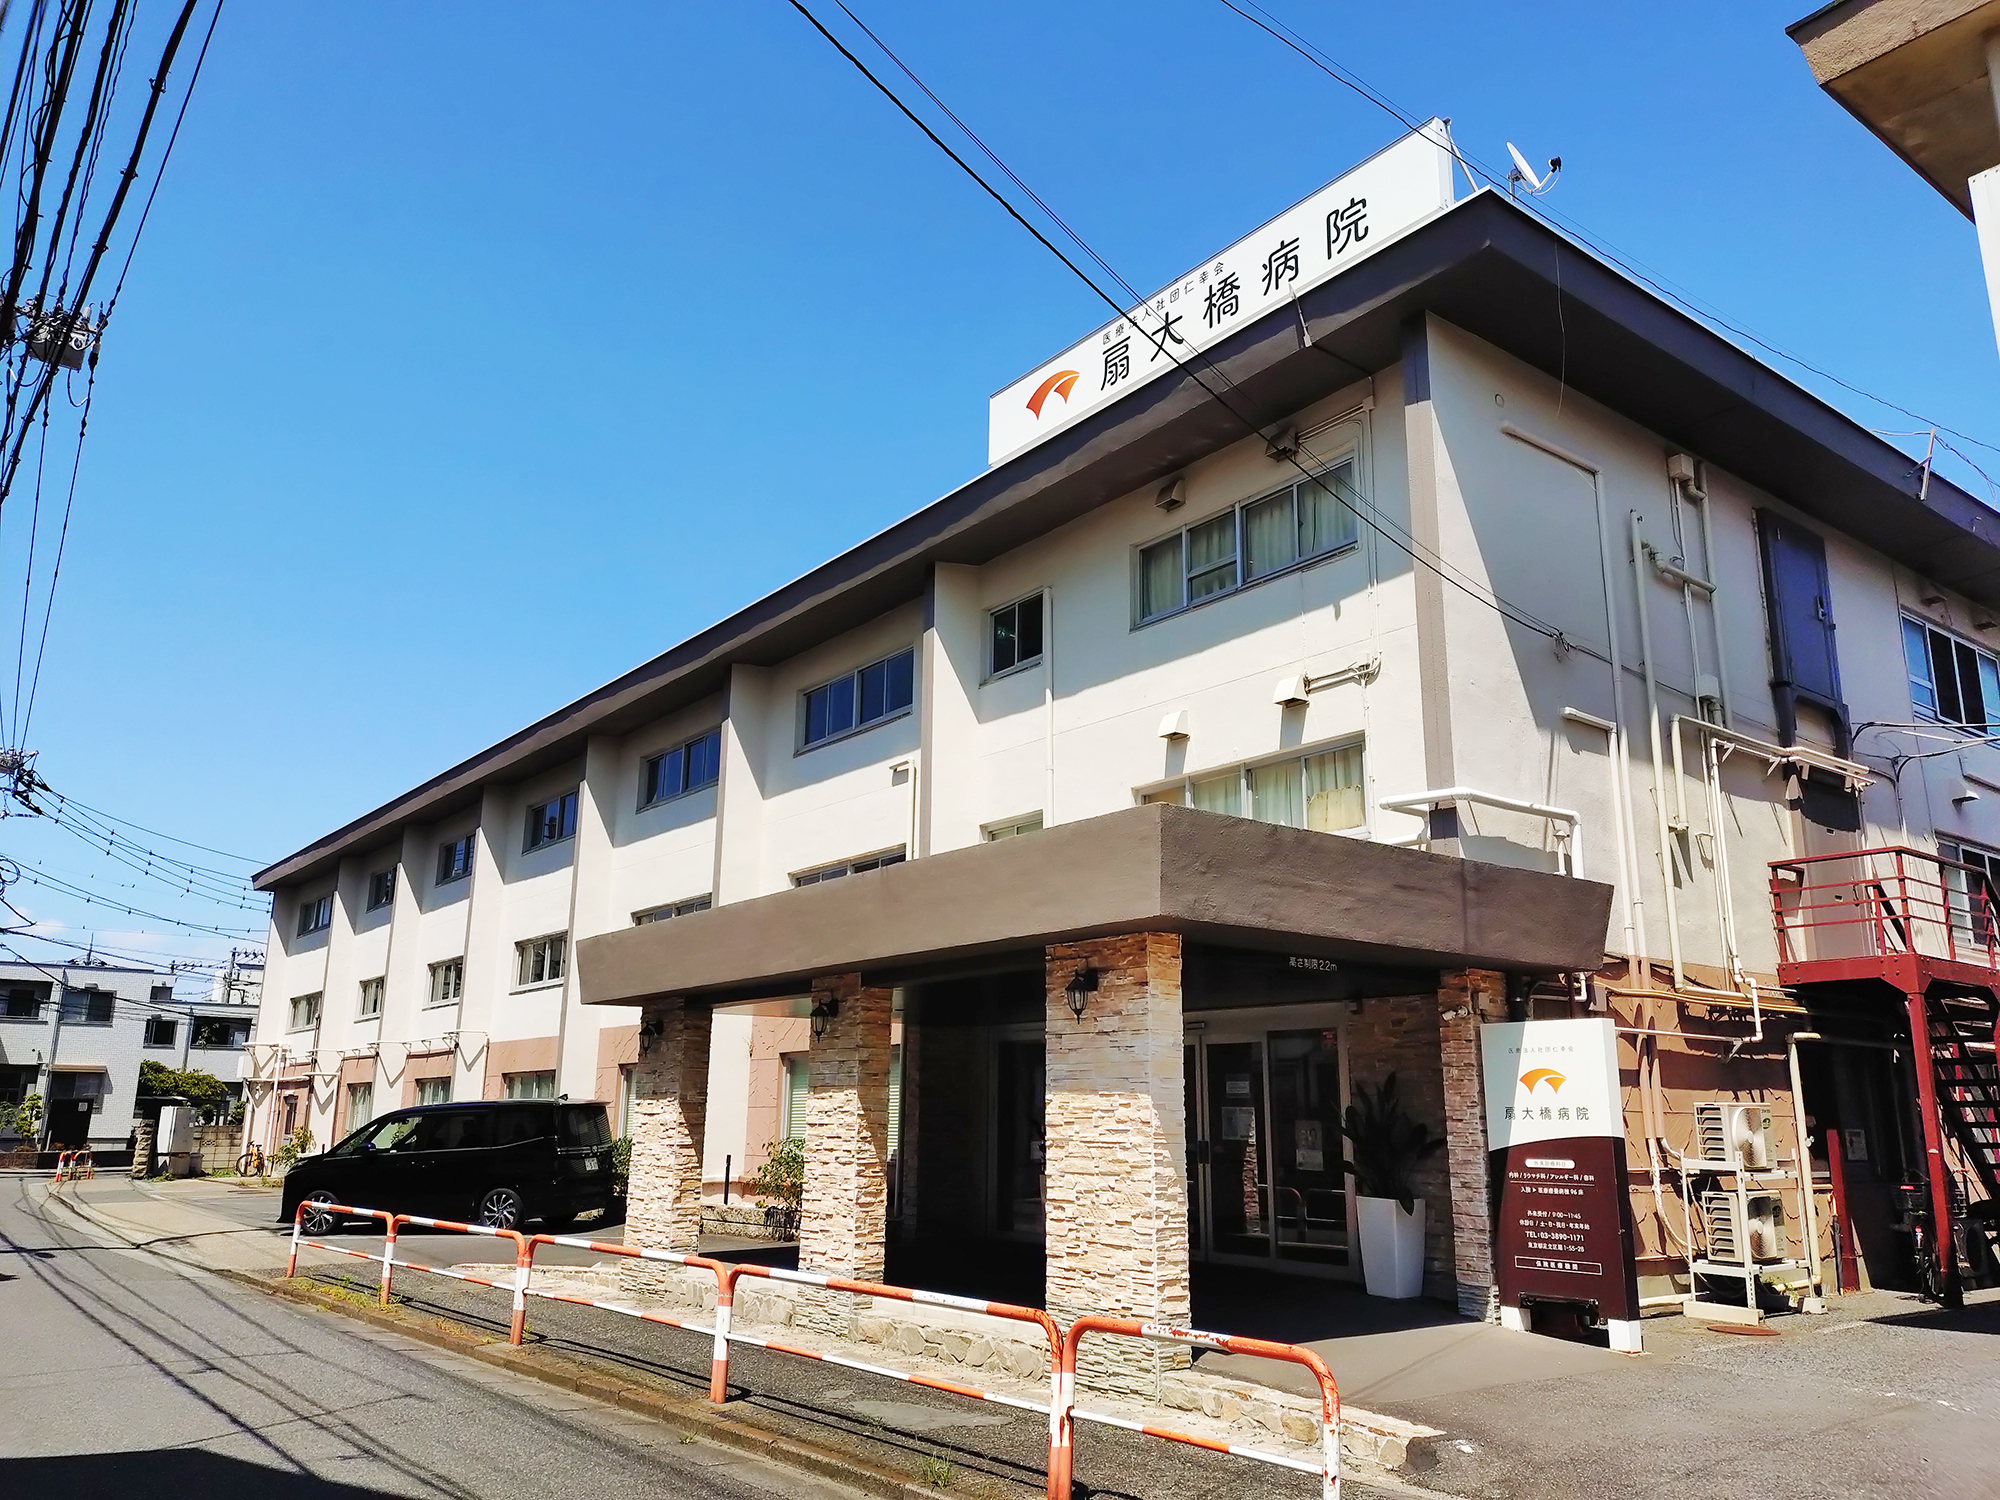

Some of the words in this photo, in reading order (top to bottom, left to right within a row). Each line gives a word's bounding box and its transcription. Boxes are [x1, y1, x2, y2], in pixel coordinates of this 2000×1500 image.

[1100, 197, 1369, 391] 扇大橋病院
[1504, 1106, 1590, 1121] 扇大橋病院
